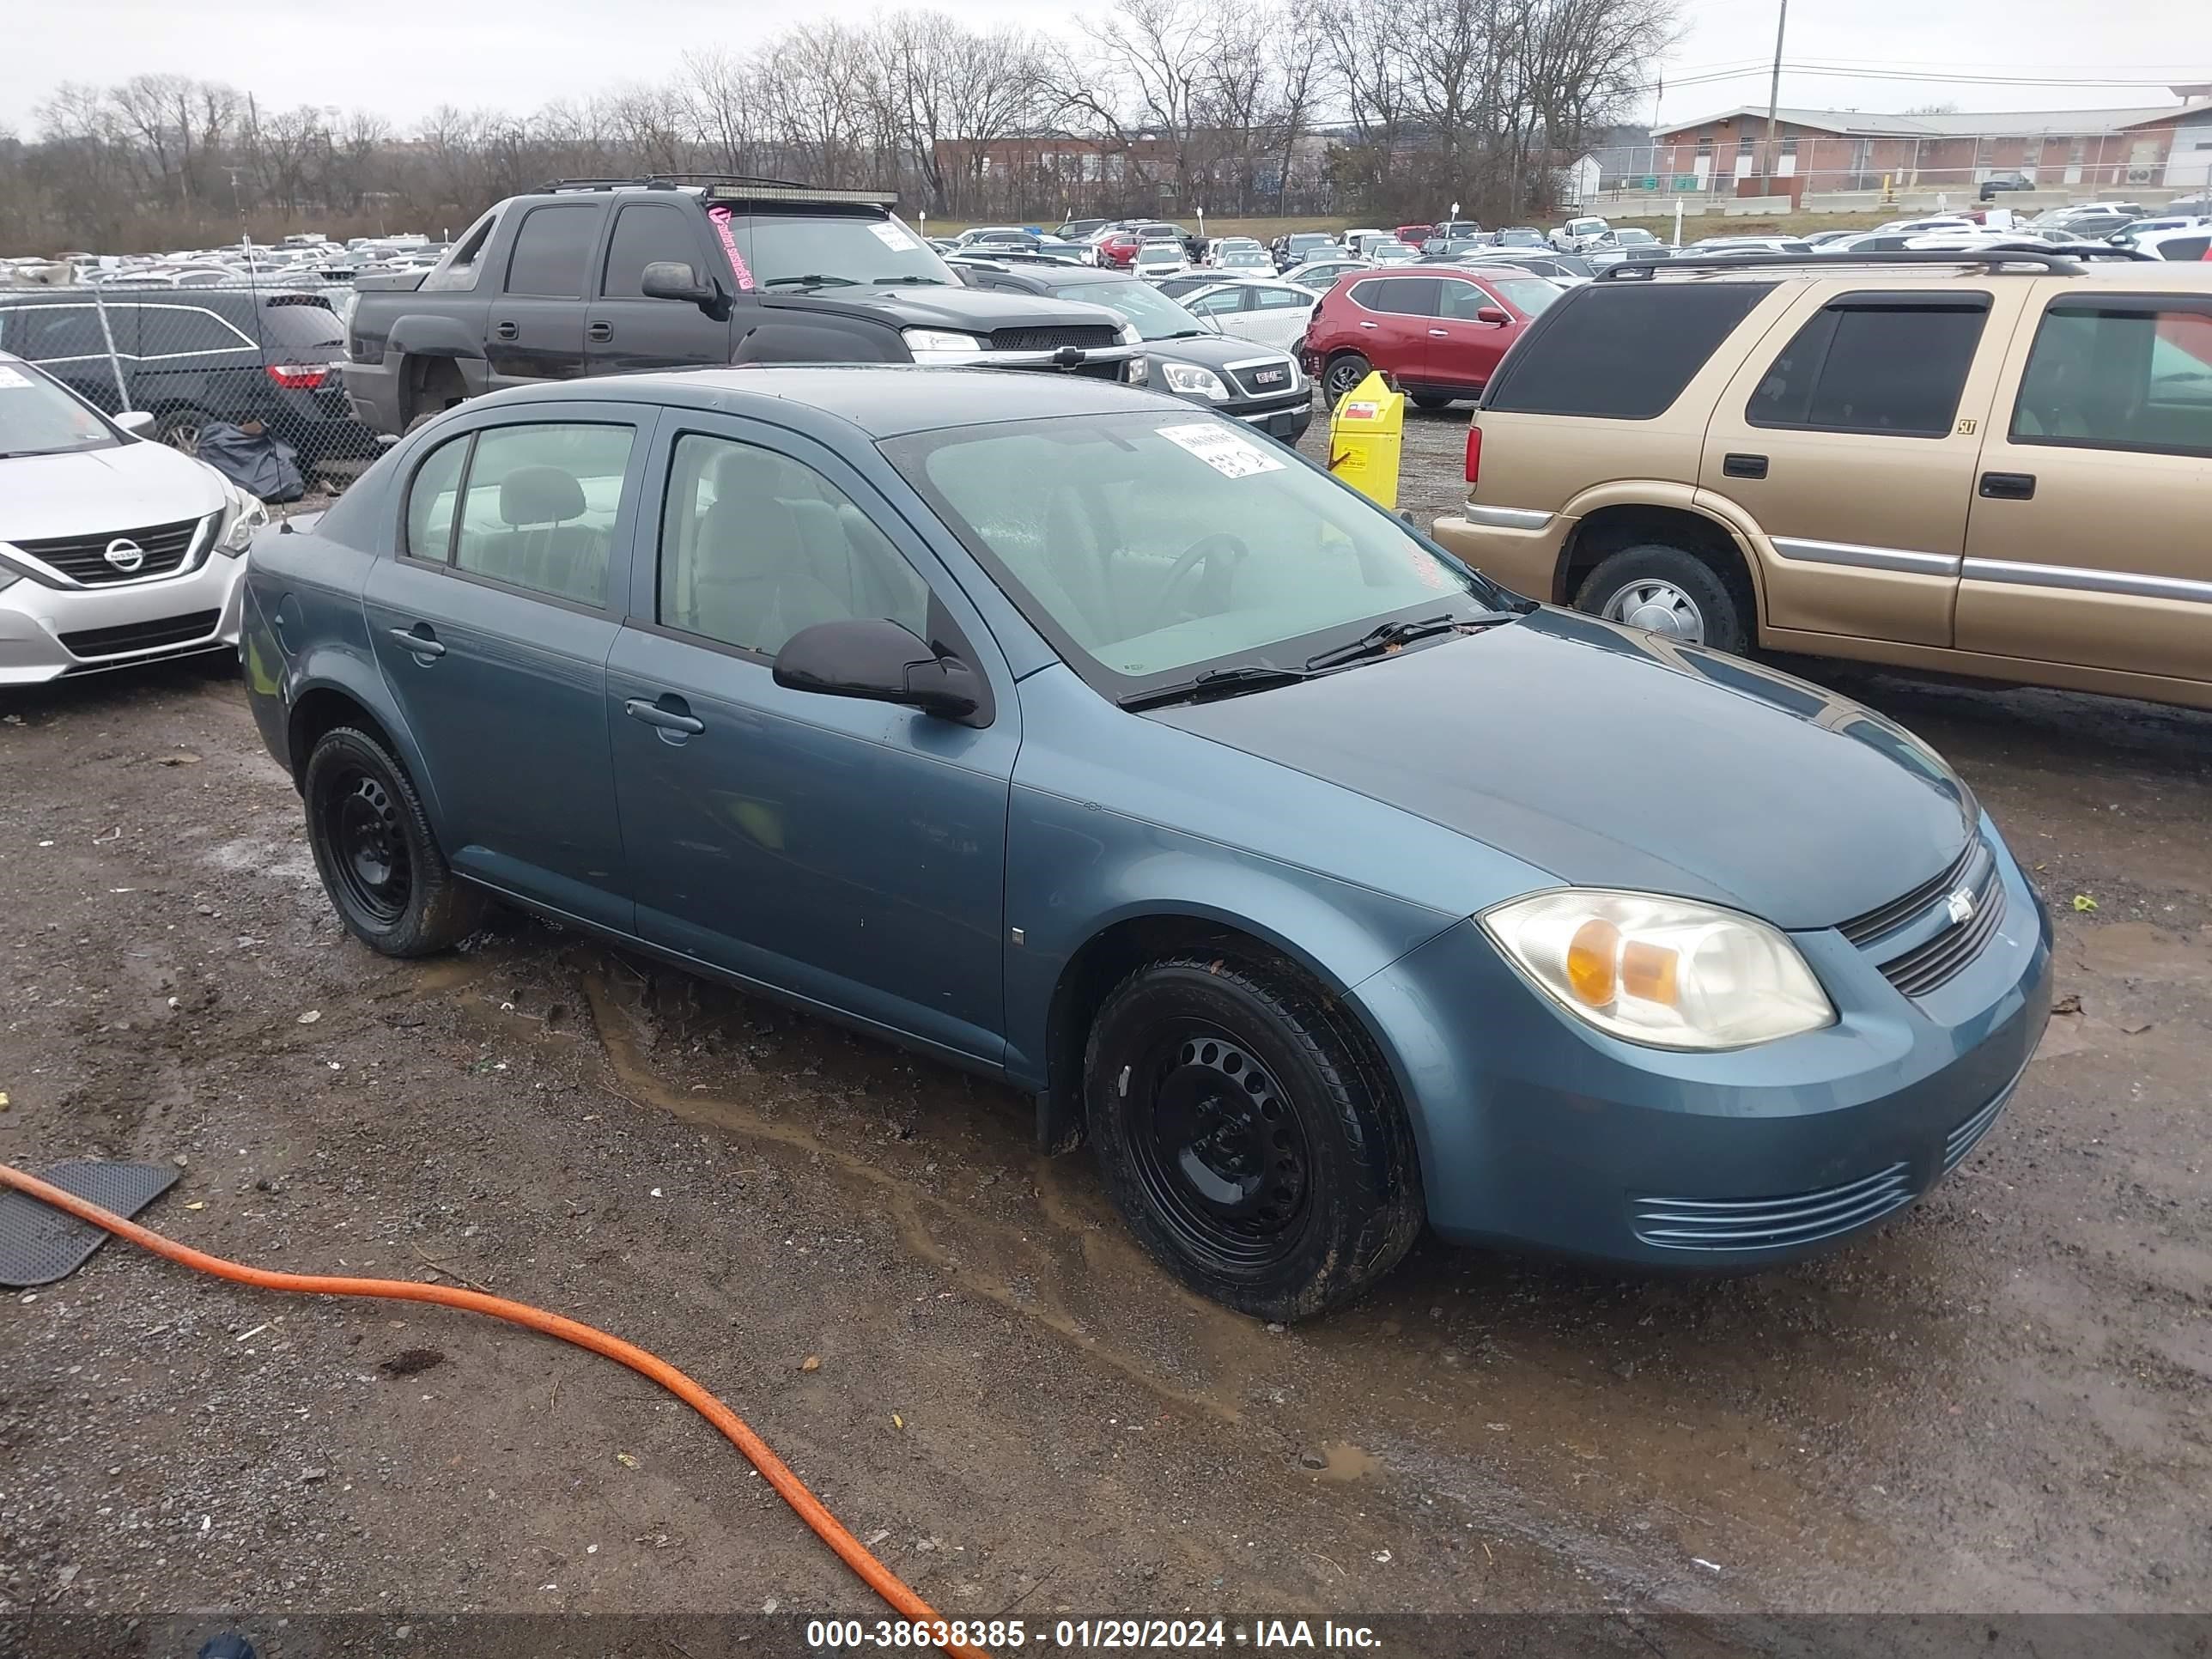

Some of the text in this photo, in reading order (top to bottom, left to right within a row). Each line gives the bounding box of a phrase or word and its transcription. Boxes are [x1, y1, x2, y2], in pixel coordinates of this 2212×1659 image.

[1255, 369, 1284, 385] GMC
[1958, 419, 1977, 434] SLT
[110, 550, 143, 560] NISSAN
